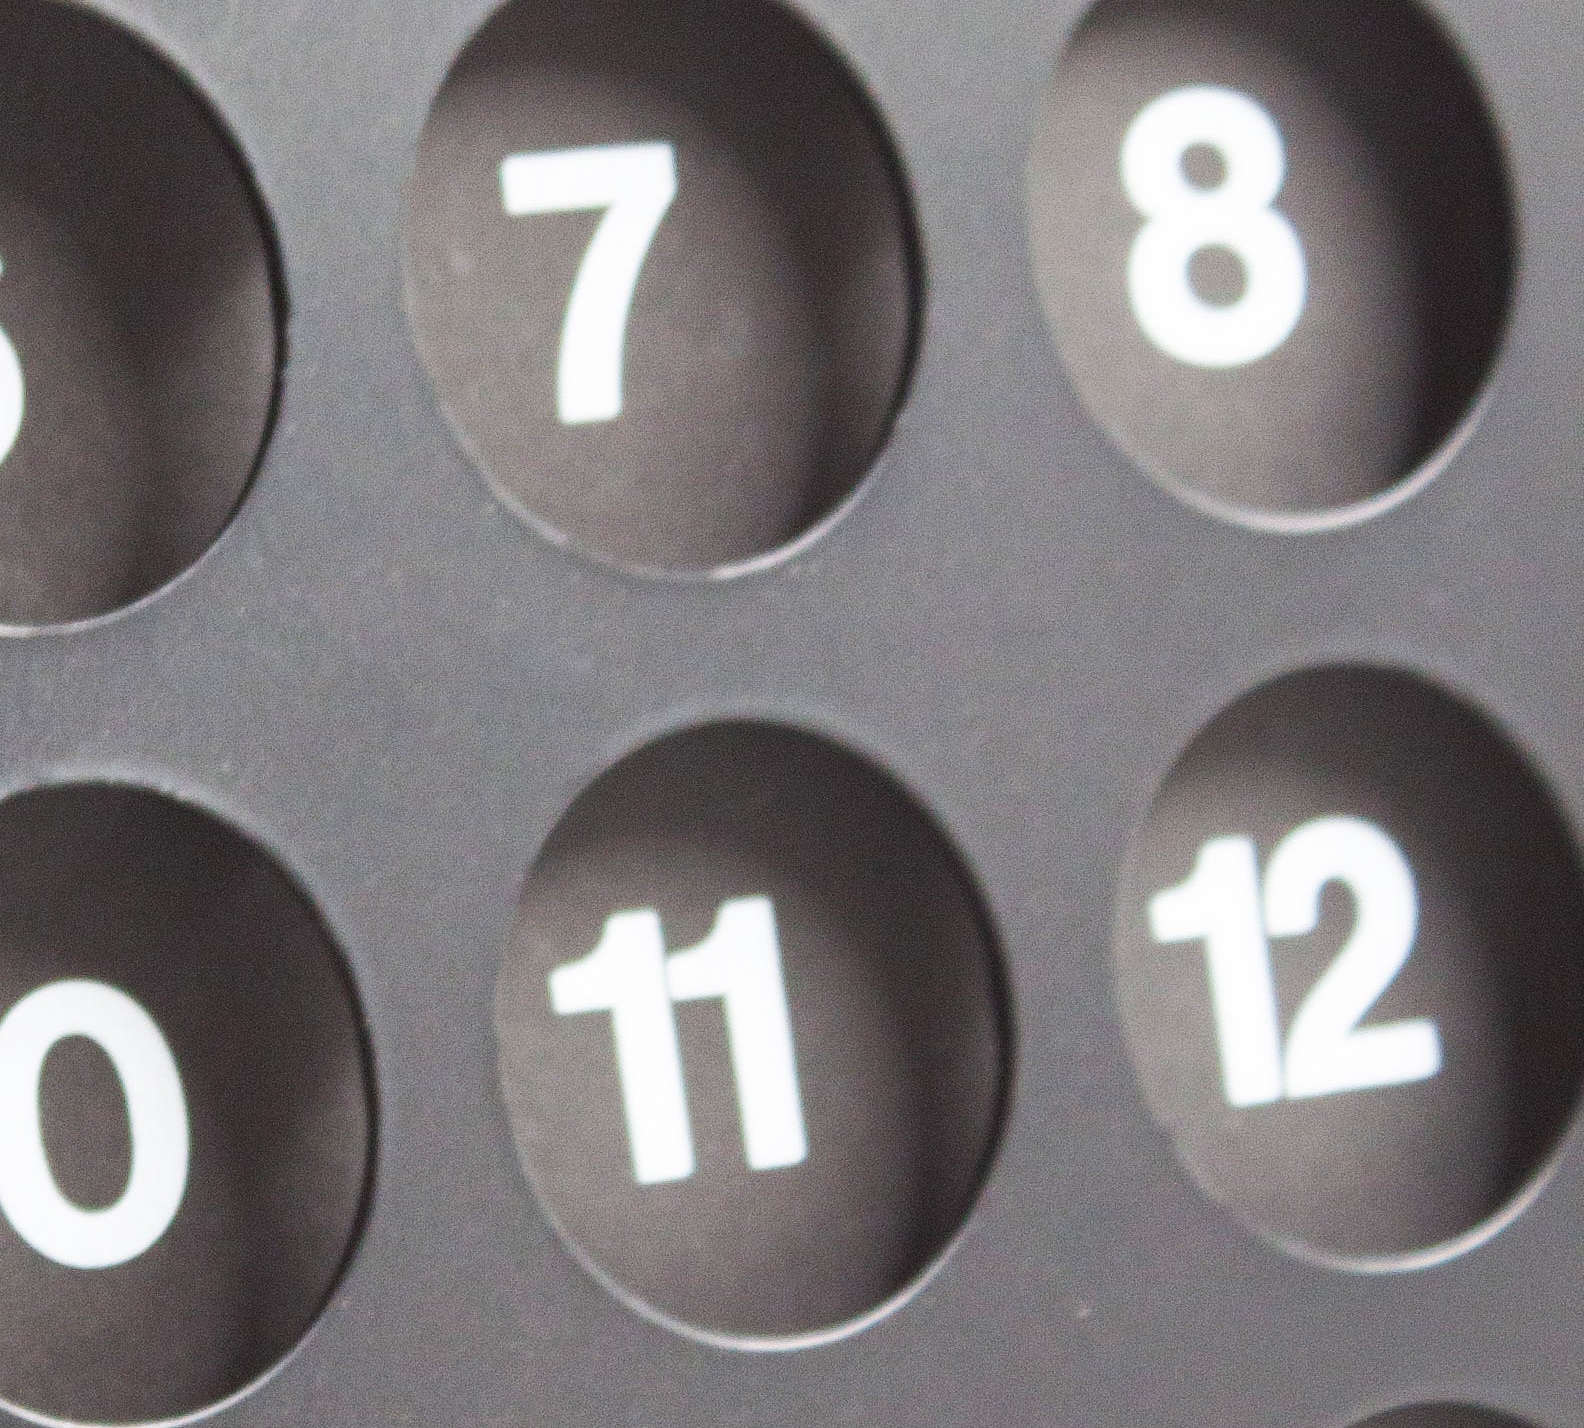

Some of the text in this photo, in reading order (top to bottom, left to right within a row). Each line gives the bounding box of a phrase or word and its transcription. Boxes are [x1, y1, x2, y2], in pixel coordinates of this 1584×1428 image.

[500, 143, 677, 426] 7
[1118, 85, 1309, 370] 8
[547, 897, 808, 1186] 11
[1147, 816, 1441, 1110] 12
